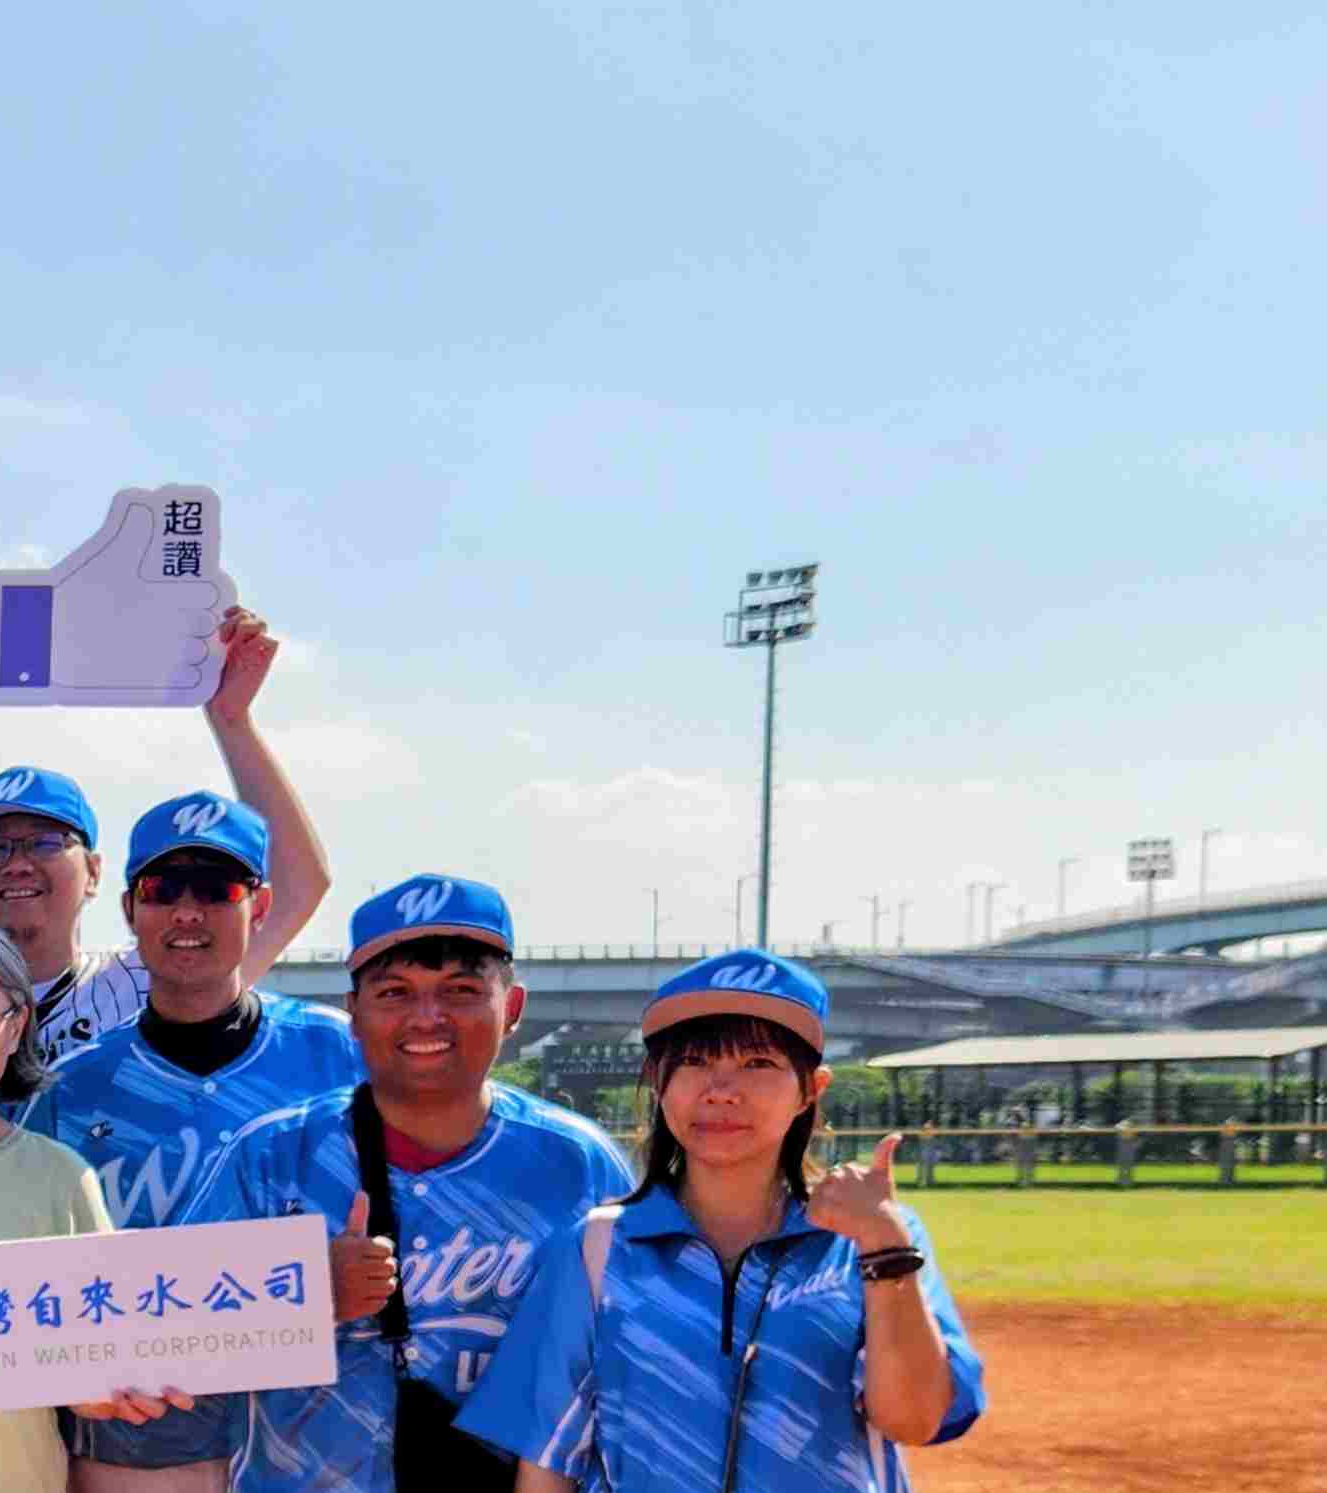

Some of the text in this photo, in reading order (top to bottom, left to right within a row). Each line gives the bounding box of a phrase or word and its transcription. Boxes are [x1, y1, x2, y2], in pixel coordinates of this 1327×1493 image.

[162, 500, 203, 577] 超讚
[172, 801, 228, 836] W
[396, 880, 452, 925] W
[400, 1226, 535, 1307] ater
[34, 1342, 116, 1366] WATER
[134, 1327, 316, 1360] CORPORATION
